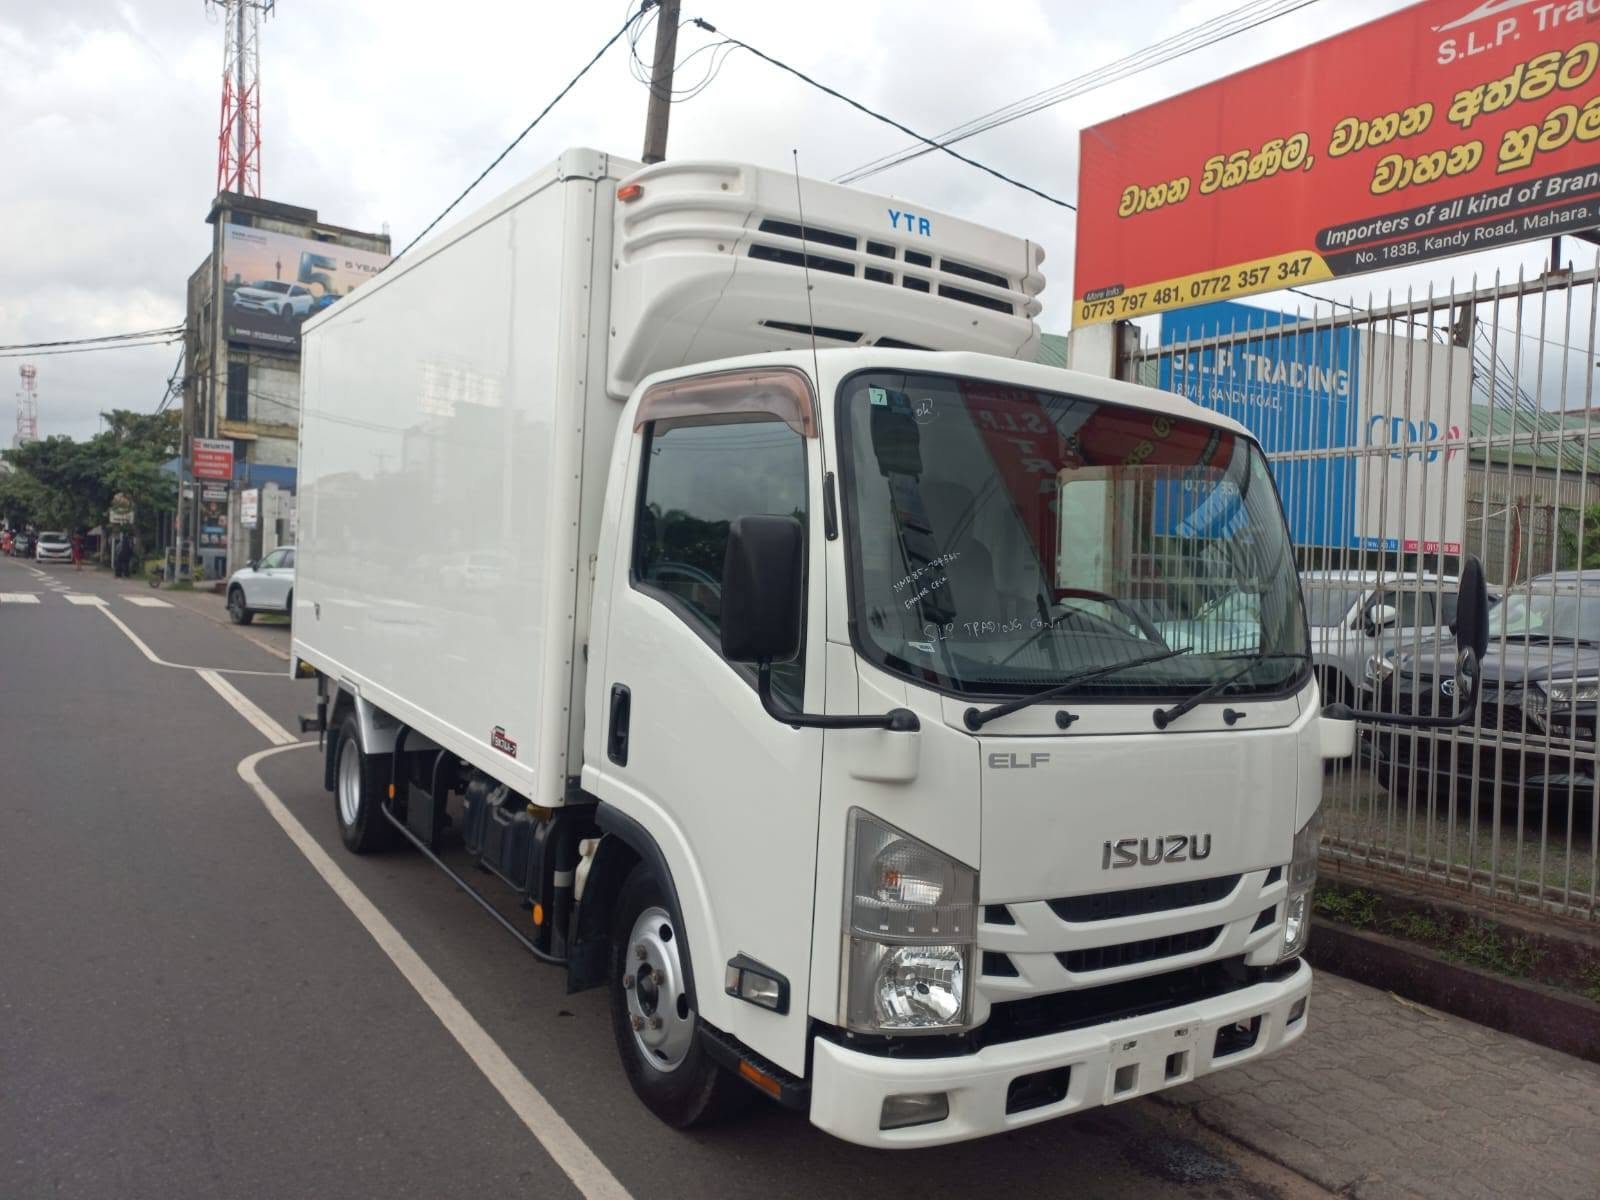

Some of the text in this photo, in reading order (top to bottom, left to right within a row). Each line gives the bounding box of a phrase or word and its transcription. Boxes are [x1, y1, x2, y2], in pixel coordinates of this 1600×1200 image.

[1437, 17, 1521, 65] S.L.P.
[1118, 176, 1191, 218] වාහන
[1328, 102, 1435, 157] වාහන
[1370, 140, 1484, 195] වාහන
[888, 208, 931, 237] YTR
[1326, 171, 1600, 246] Importers of all kind of Bran
[1355, 206, 1593, 264] No. 183B, Kandy Road, Mahara.
[1081, 300, 1115, 320] 0773
[1121, 292, 1148, 313] 797
[1190, 275, 1231, 298] 0772
[1238, 266, 1270, 288] 357
[1277, 257, 1313, 280] 347
[1242, 352, 1349, 396] TRADING
[988, 752, 1050, 769] ELF
[1101, 834, 1211, 871] ISUZU
